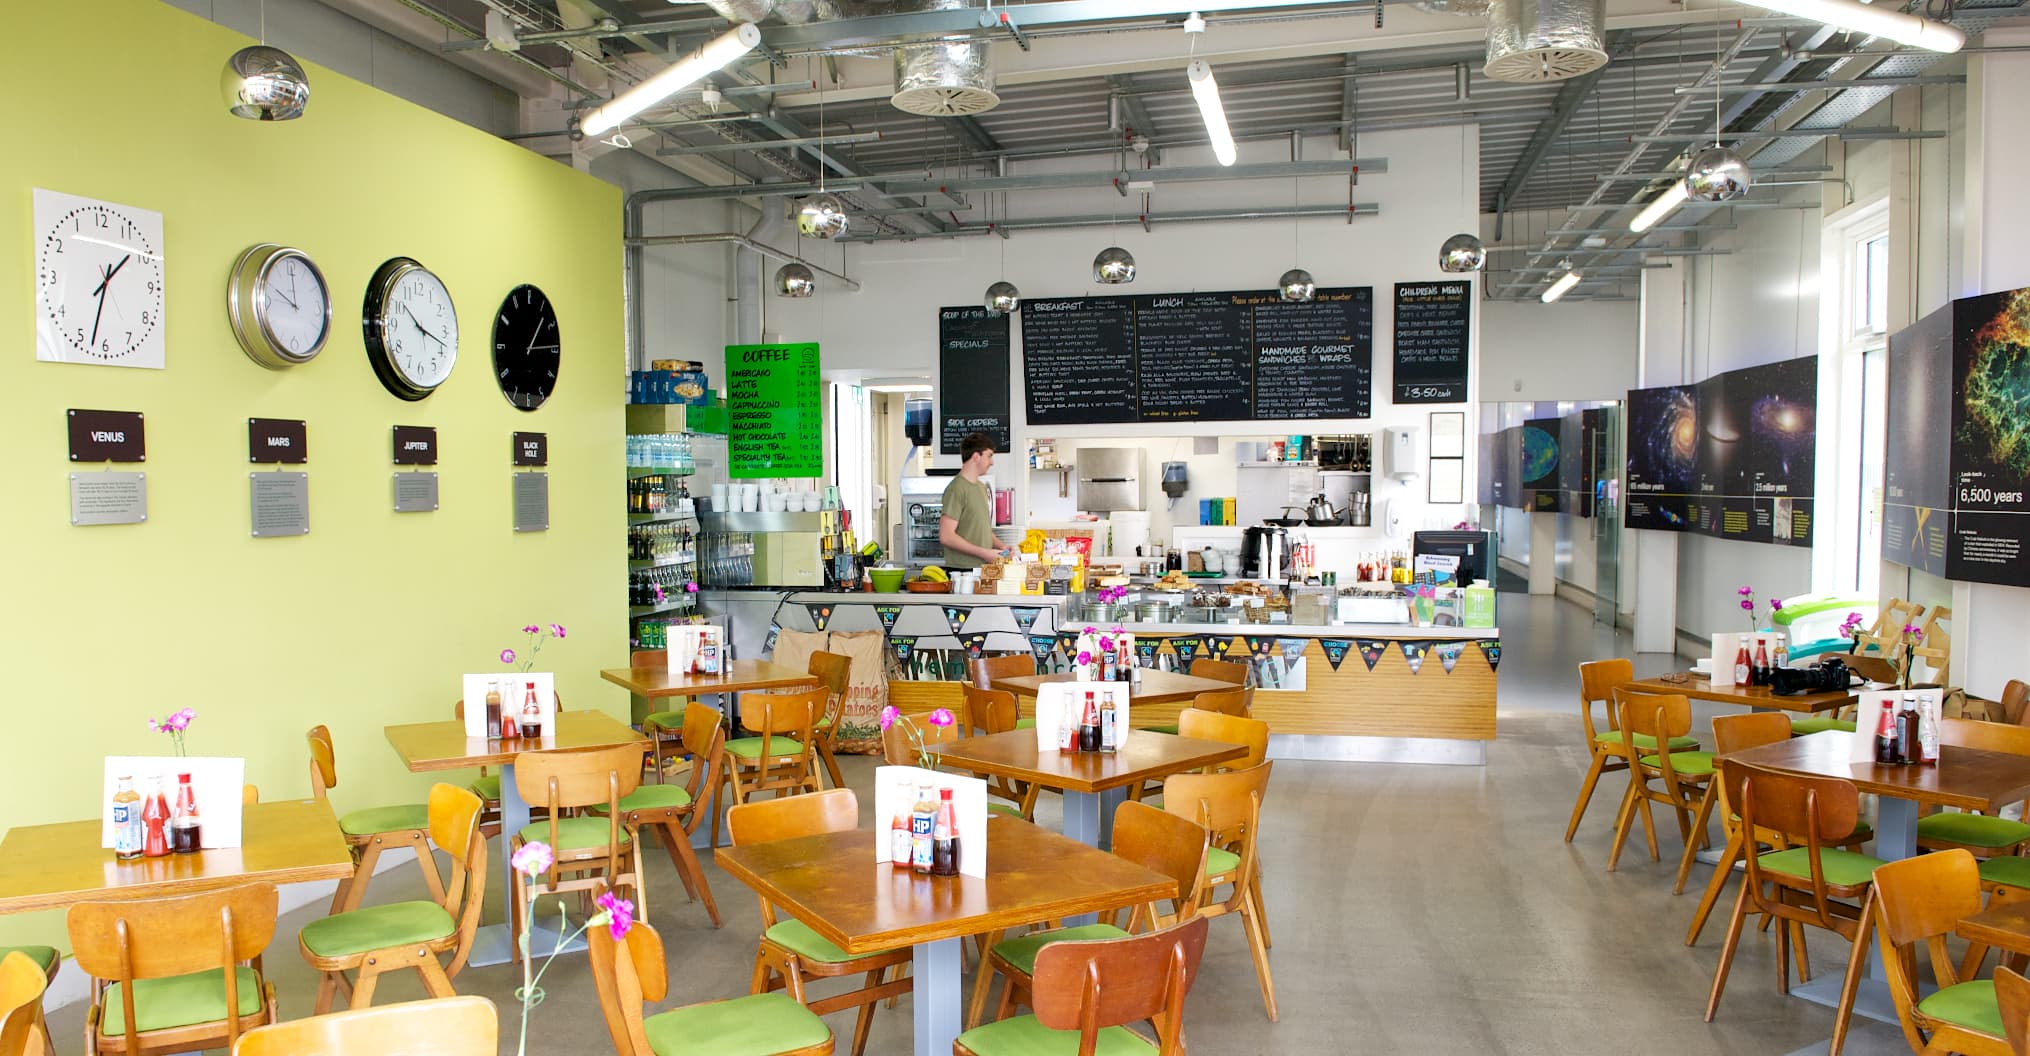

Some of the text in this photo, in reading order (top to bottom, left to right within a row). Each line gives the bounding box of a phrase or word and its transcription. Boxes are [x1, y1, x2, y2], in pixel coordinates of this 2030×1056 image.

[75, 218, 79, 232] 1
[95, 212, 108, 228] 12
[121, 224, 132, 240] 11
[56, 239, 64, 253] 2
[50, 270, 56, 285] 3
[147, 282, 154, 295] 9
[403, 286, 412, 300] 11
[414, 282, 424, 296] 12
[1442, 285, 1463, 295] MENU
[395, 301, 404, 314] 10
[1033, 301, 1085, 312] BREAKFAST
[1152, 298, 1184, 308] LUNCH
[58, 304, 66, 318] 4
[436, 304, 442, 317] 2
[142, 311, 149, 324] 8
[391, 318, 397, 331] 9
[77, 329, 84, 342] 5
[125, 332, 132, 344] 7
[441, 325, 448, 339] 3
[102, 339, 109, 352] 6
[290, 336, 299, 351] 6
[395, 339, 402, 353] 8
[949, 340, 989, 349] SPECIALS
[1261, 345, 1355, 355] HANDMADE GOURMET
[406, 355, 412, 369] 7
[742, 348, 791, 363] COFFEE
[1258, 354, 1352, 364] SANDWICHES WRAPS
[418, 361, 424, 376] 6
[432, 358, 437, 372] 5
[731, 369, 770, 377] AMERICANO
[732, 380, 757, 389] LATTE
[732, 391, 759, 400] MOCHA
[732, 400, 780, 409] CAPPUCCINO
[732, 412, 772, 420] ESPRESSO
[947, 418, 998, 426] SIDE ORDERS
[733, 422, 772, 430] MACCHIATO
[91, 432, 125, 442] VENUS
[268, 437, 290, 446] MARS
[748, 432, 786, 440] CHOCOLATE
[404, 442, 428, 450] JUPITER
[734, 443, 763, 452] ENGLISH
[734, 454, 770, 462] SPECIALITY
[1961, 488, 2023, 504] 6,500 years
[847, 682, 878, 702] pping
[829, 700, 878, 716] Patoes
[914, 819, 930, 833] HP
